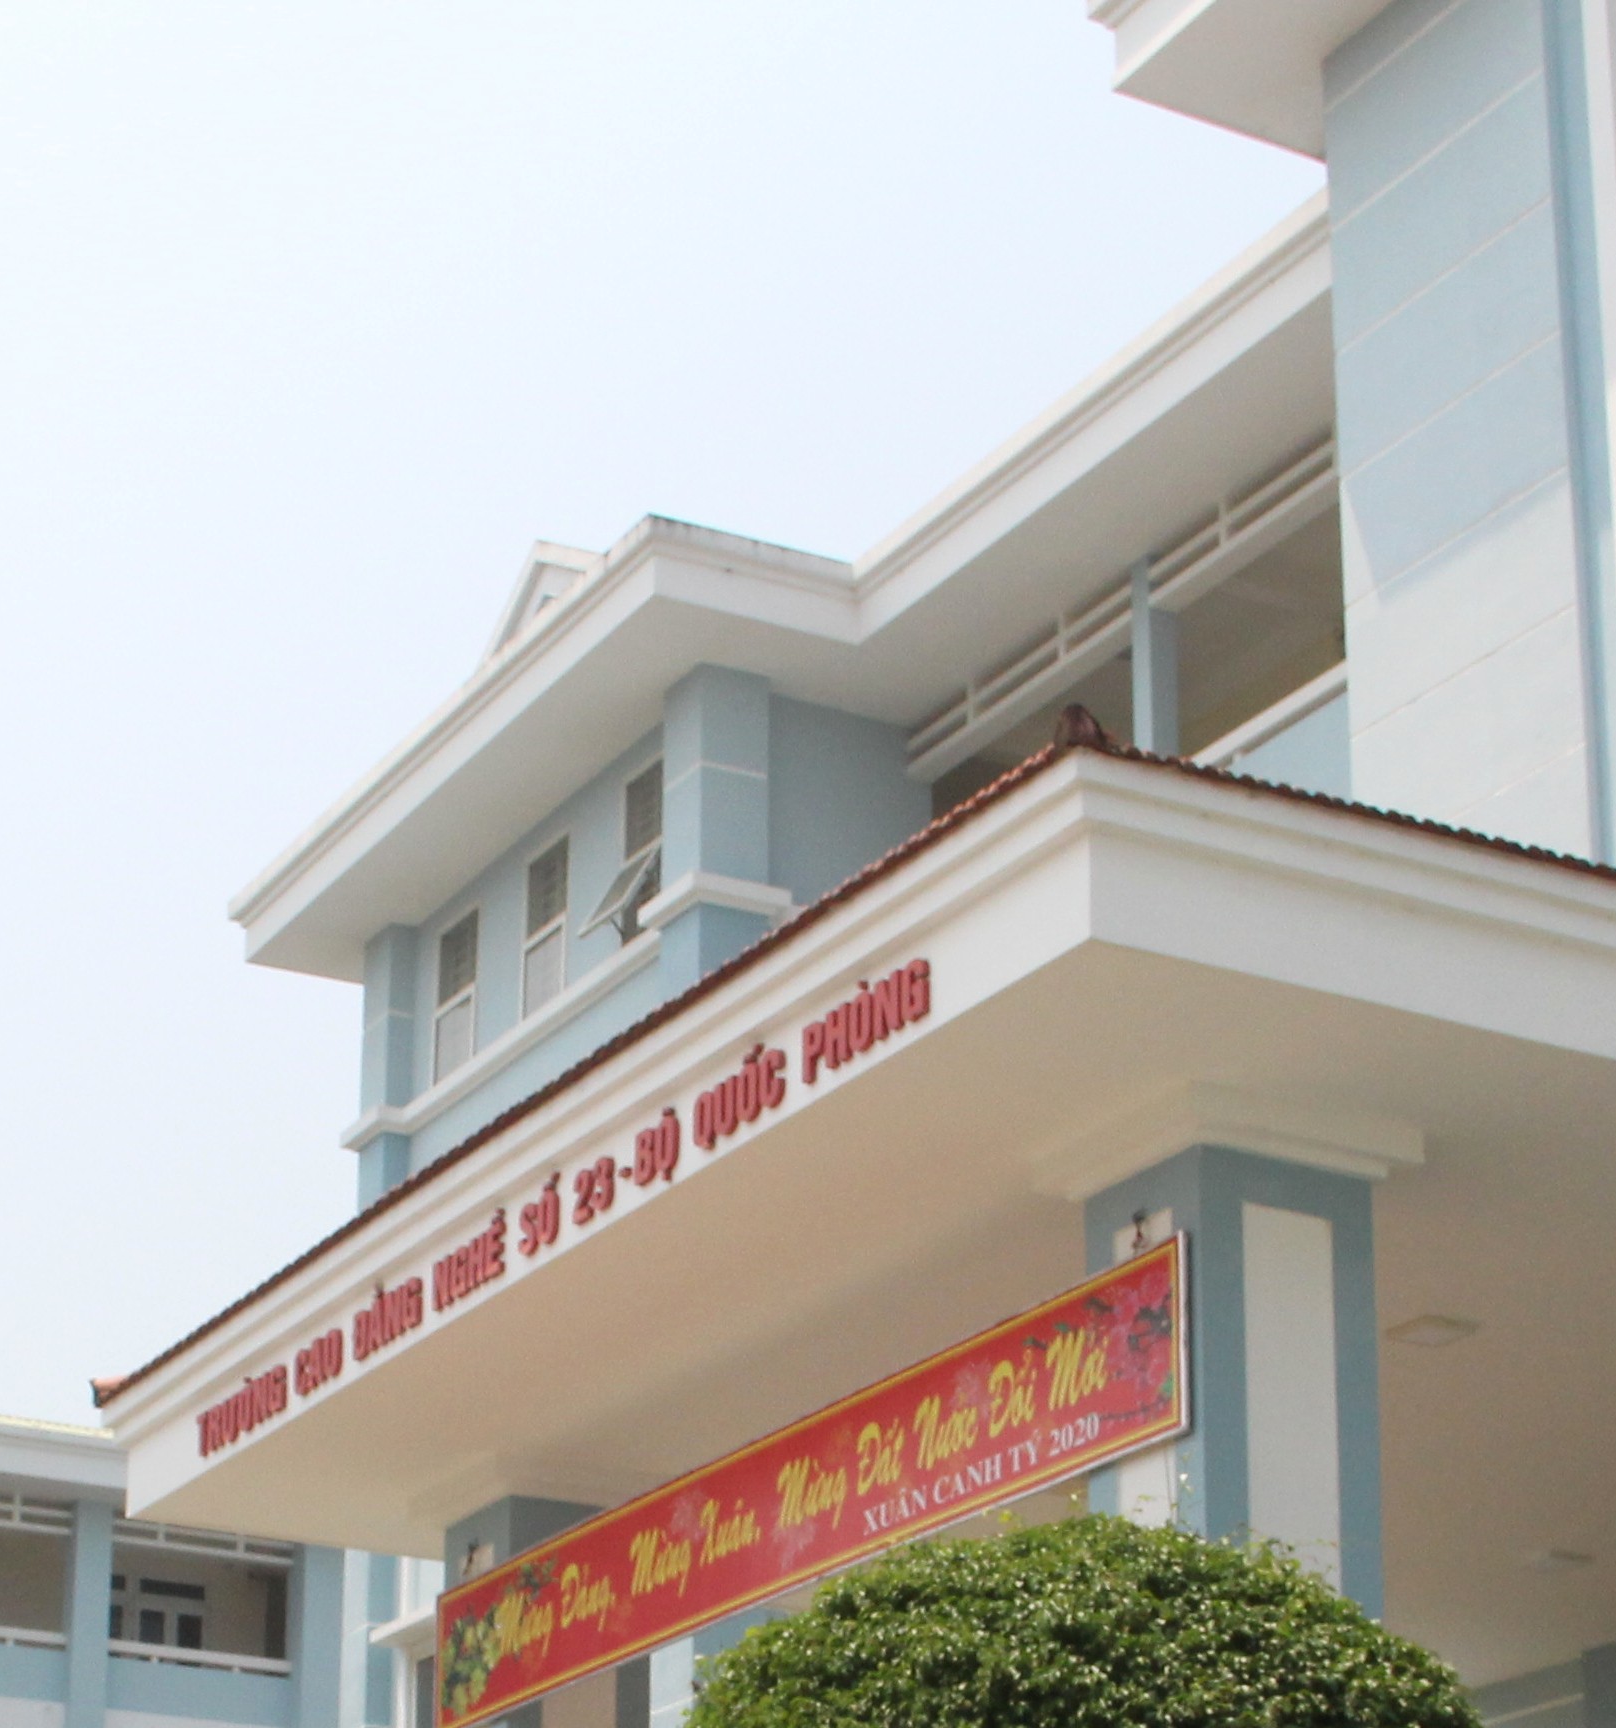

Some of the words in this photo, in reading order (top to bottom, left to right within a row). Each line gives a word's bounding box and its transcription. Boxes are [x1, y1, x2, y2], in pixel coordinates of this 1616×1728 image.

[294, 1328, 343, 1397] CAO
[518, 1171, 561, 1257] SỐ
[693, 1043, 787, 1152] QUỐC
[802, 958, 931, 1085] PHÒNG
[863, 1484, 928, 1536] XUÂN
[934, 1453, 1002, 1505] CANH
[1049, 1412, 1101, 1457] 2020
